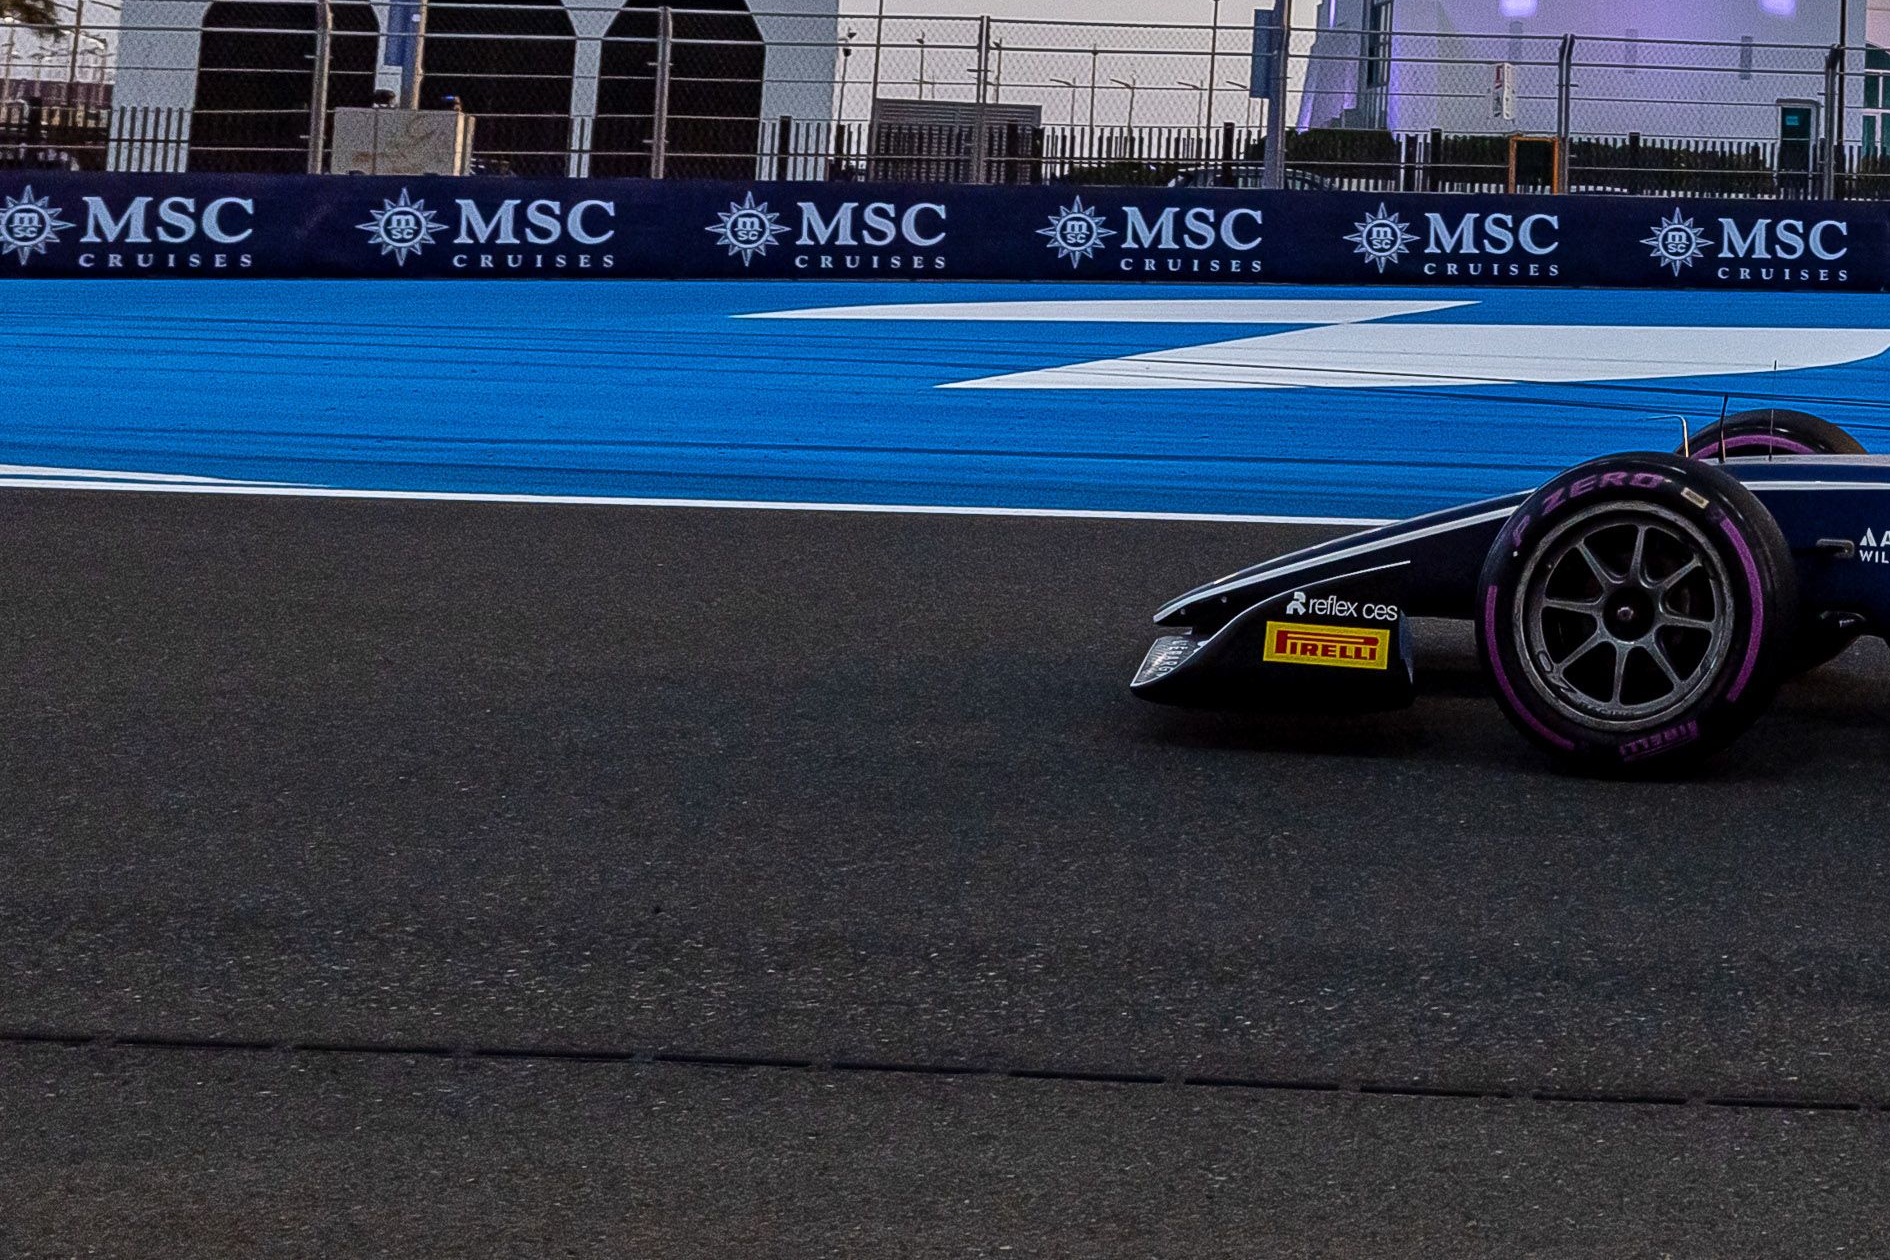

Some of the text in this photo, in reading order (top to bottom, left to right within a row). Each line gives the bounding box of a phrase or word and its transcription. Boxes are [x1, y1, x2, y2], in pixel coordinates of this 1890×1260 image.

[79, 196, 254, 244] MSC
[453, 198, 616, 245] MSC
[795, 201, 947, 247] MSC
[1120, 206, 1263, 251] MSC
[1423, 212, 1559, 255] MSC
[1717, 217, 1848, 261] MSC
[78, 253, 252, 268] CRUISES
[452, 254, 614, 268] CRUISES
[794, 255, 945, 269] CRUISES
[1120, 258, 1262, 273] CRUISES
[1423, 262, 1559, 276] CRUISES
[1717, 267, 1848, 282] CRUISES
[1540, 471, 1665, 516] ZERO
[1308, 595, 1399, 621] reflex ces
[1274, 629, 1380, 661] PIRELLI
